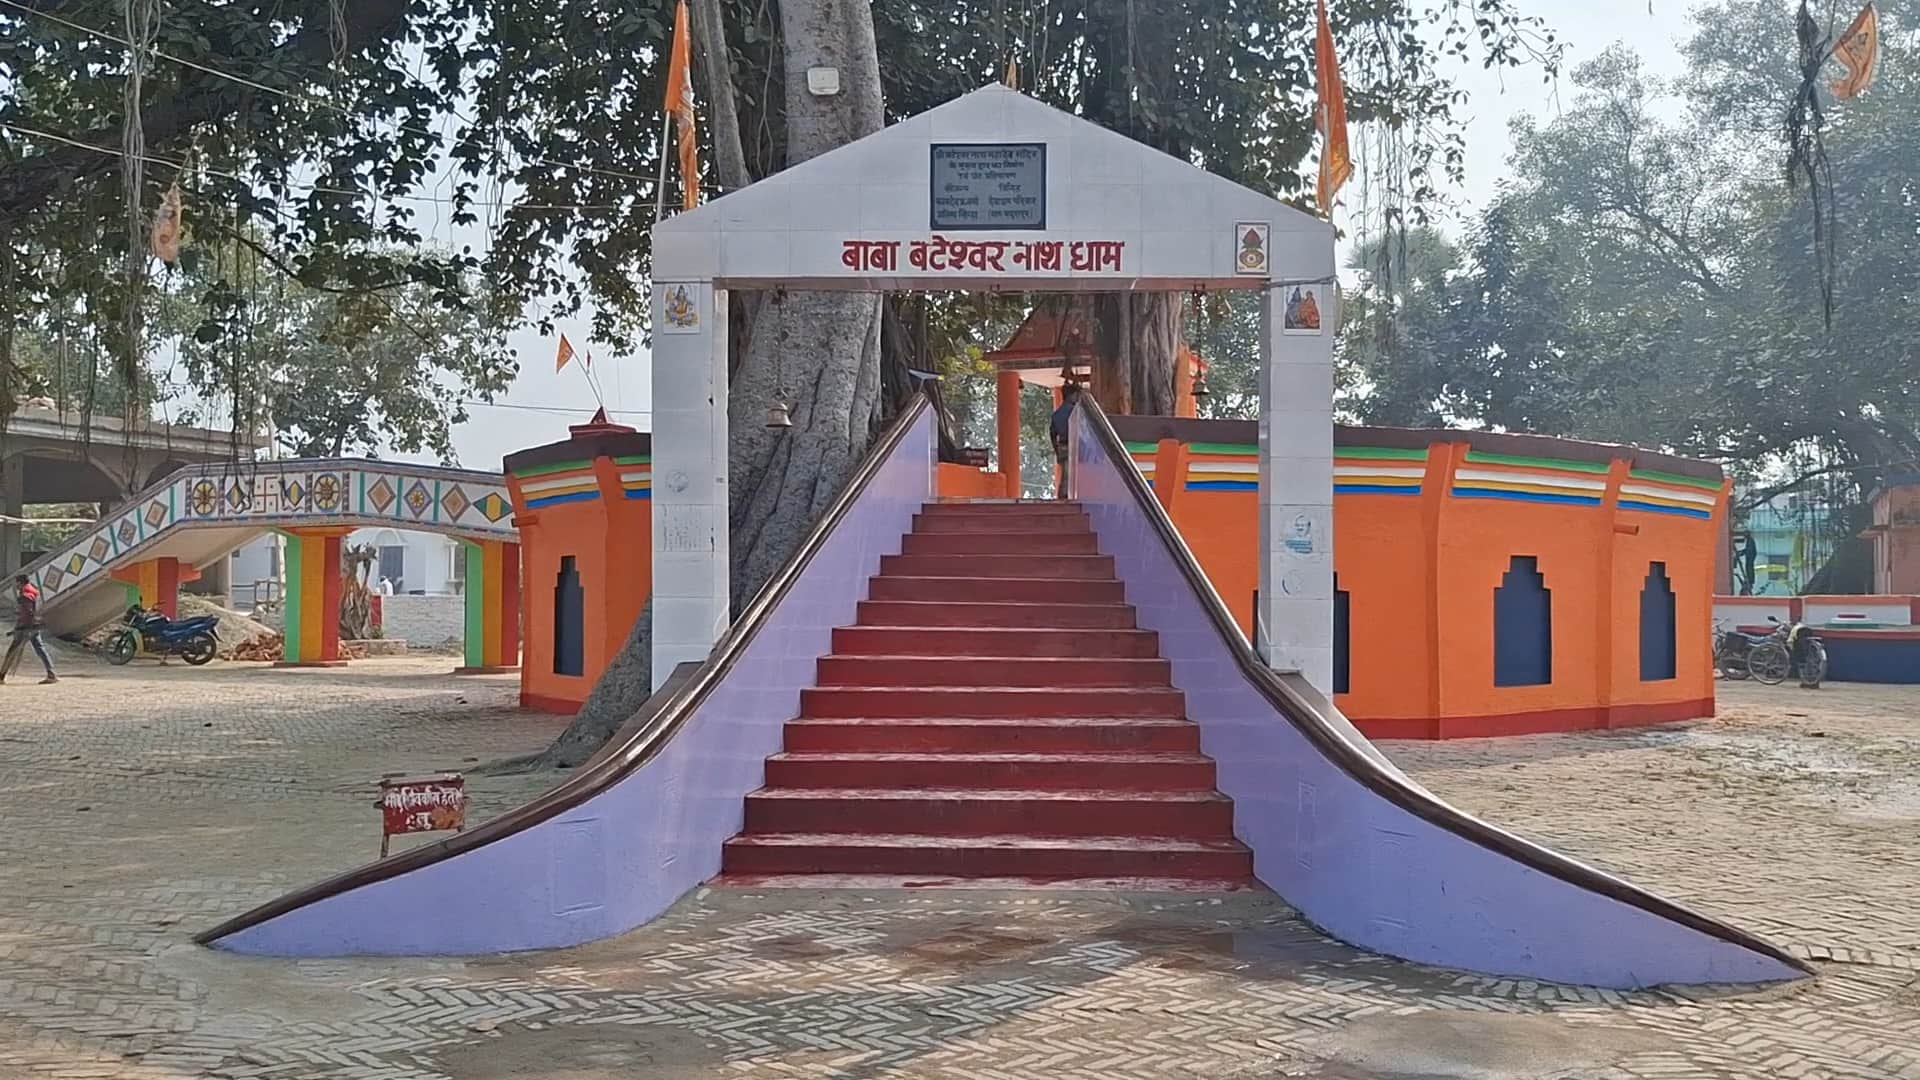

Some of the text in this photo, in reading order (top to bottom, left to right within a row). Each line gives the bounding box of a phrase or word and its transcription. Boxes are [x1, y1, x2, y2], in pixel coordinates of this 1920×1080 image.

[841, 235, 1126, 272] बाबा बटेश्वर नाथ धाम
